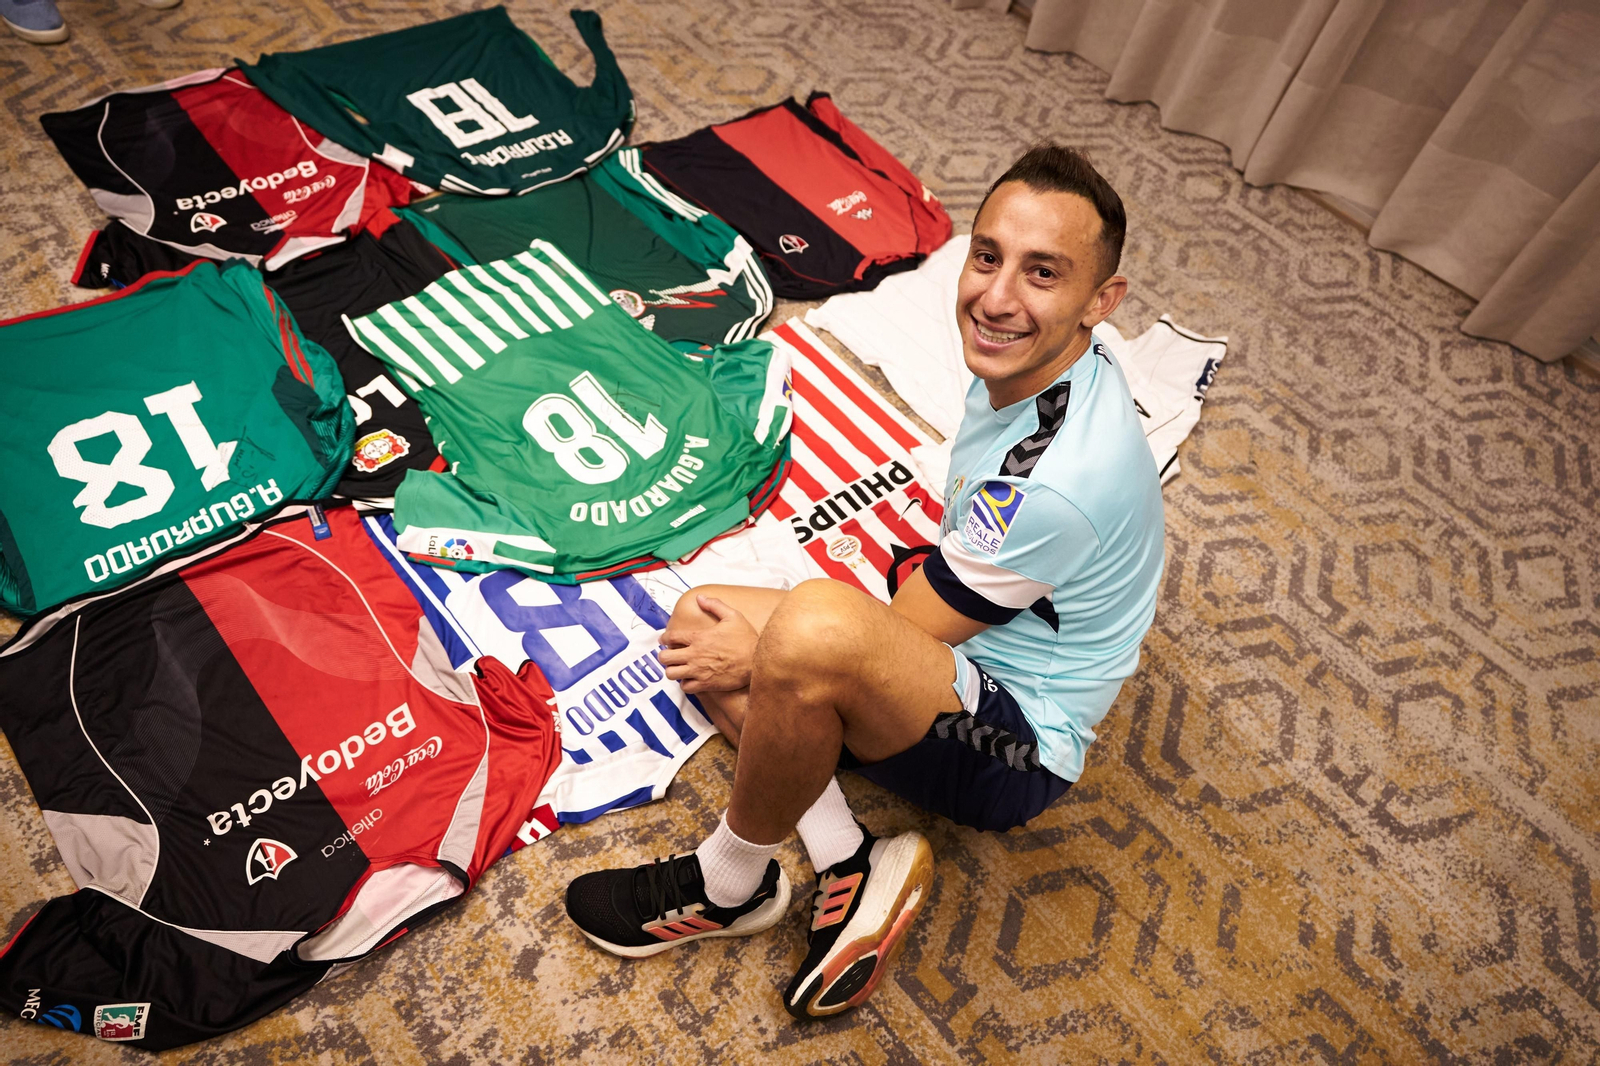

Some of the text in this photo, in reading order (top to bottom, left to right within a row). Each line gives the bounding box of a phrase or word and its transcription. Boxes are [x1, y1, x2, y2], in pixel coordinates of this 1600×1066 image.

[406, 77, 540, 148] 18
[460, 129, 574, 167] A.GUARDA
[176, 160, 318, 210] Bedoyecta
[46, 380, 238, 529] 18
[522, 370, 669, 485] 18
[569, 434, 710, 527] A.GUARDADO
[790, 460, 914, 544] PHILIPS
[83, 477, 284, 583] A.GUARDADO
[428, 535, 439, 556] LaLi
[967, 516, 1001, 549] REALE
[206, 702, 417, 836] Bedoyecta
[365, 735, 443, 798] Coca-Cola
[320, 808, 383, 859] atletica
